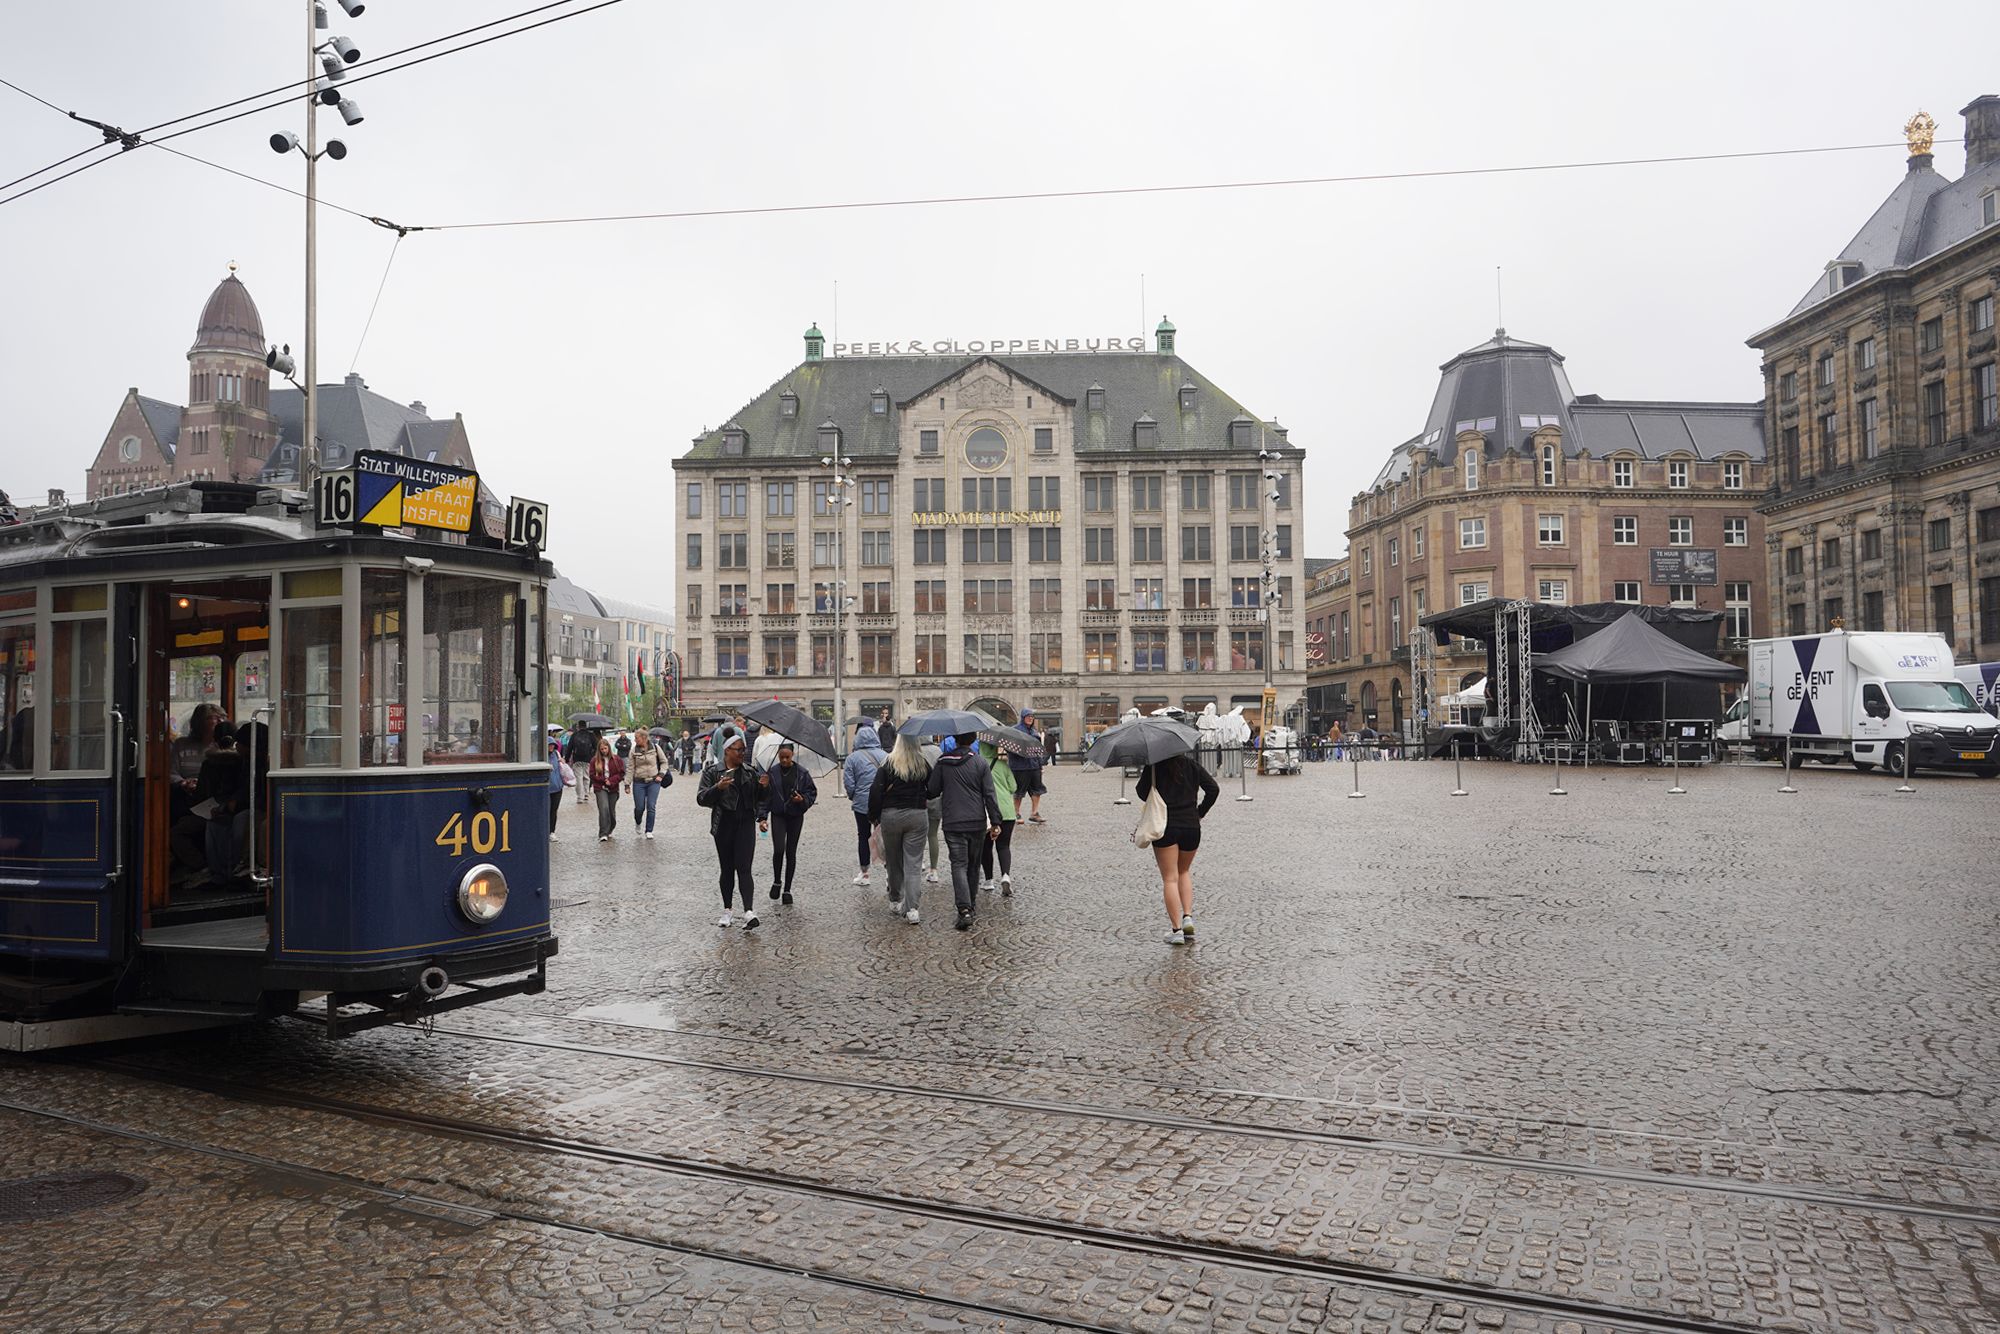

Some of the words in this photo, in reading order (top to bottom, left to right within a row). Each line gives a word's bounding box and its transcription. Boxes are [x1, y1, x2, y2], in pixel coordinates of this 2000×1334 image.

[359, 455, 391, 474] STAT
[395, 462, 475, 490] WILLEMSPARK
[324, 475, 351, 521] 16
[512, 503, 543, 544] 16
[912, 512, 984, 525] MADAME
[1898, 660, 1929, 668] GEAR
[1795, 671, 1834, 686] EVENT
[1787, 686, 1818, 700] GEAR
[389, 720, 405, 730] NIET
[436, 810, 511, 857] 401
